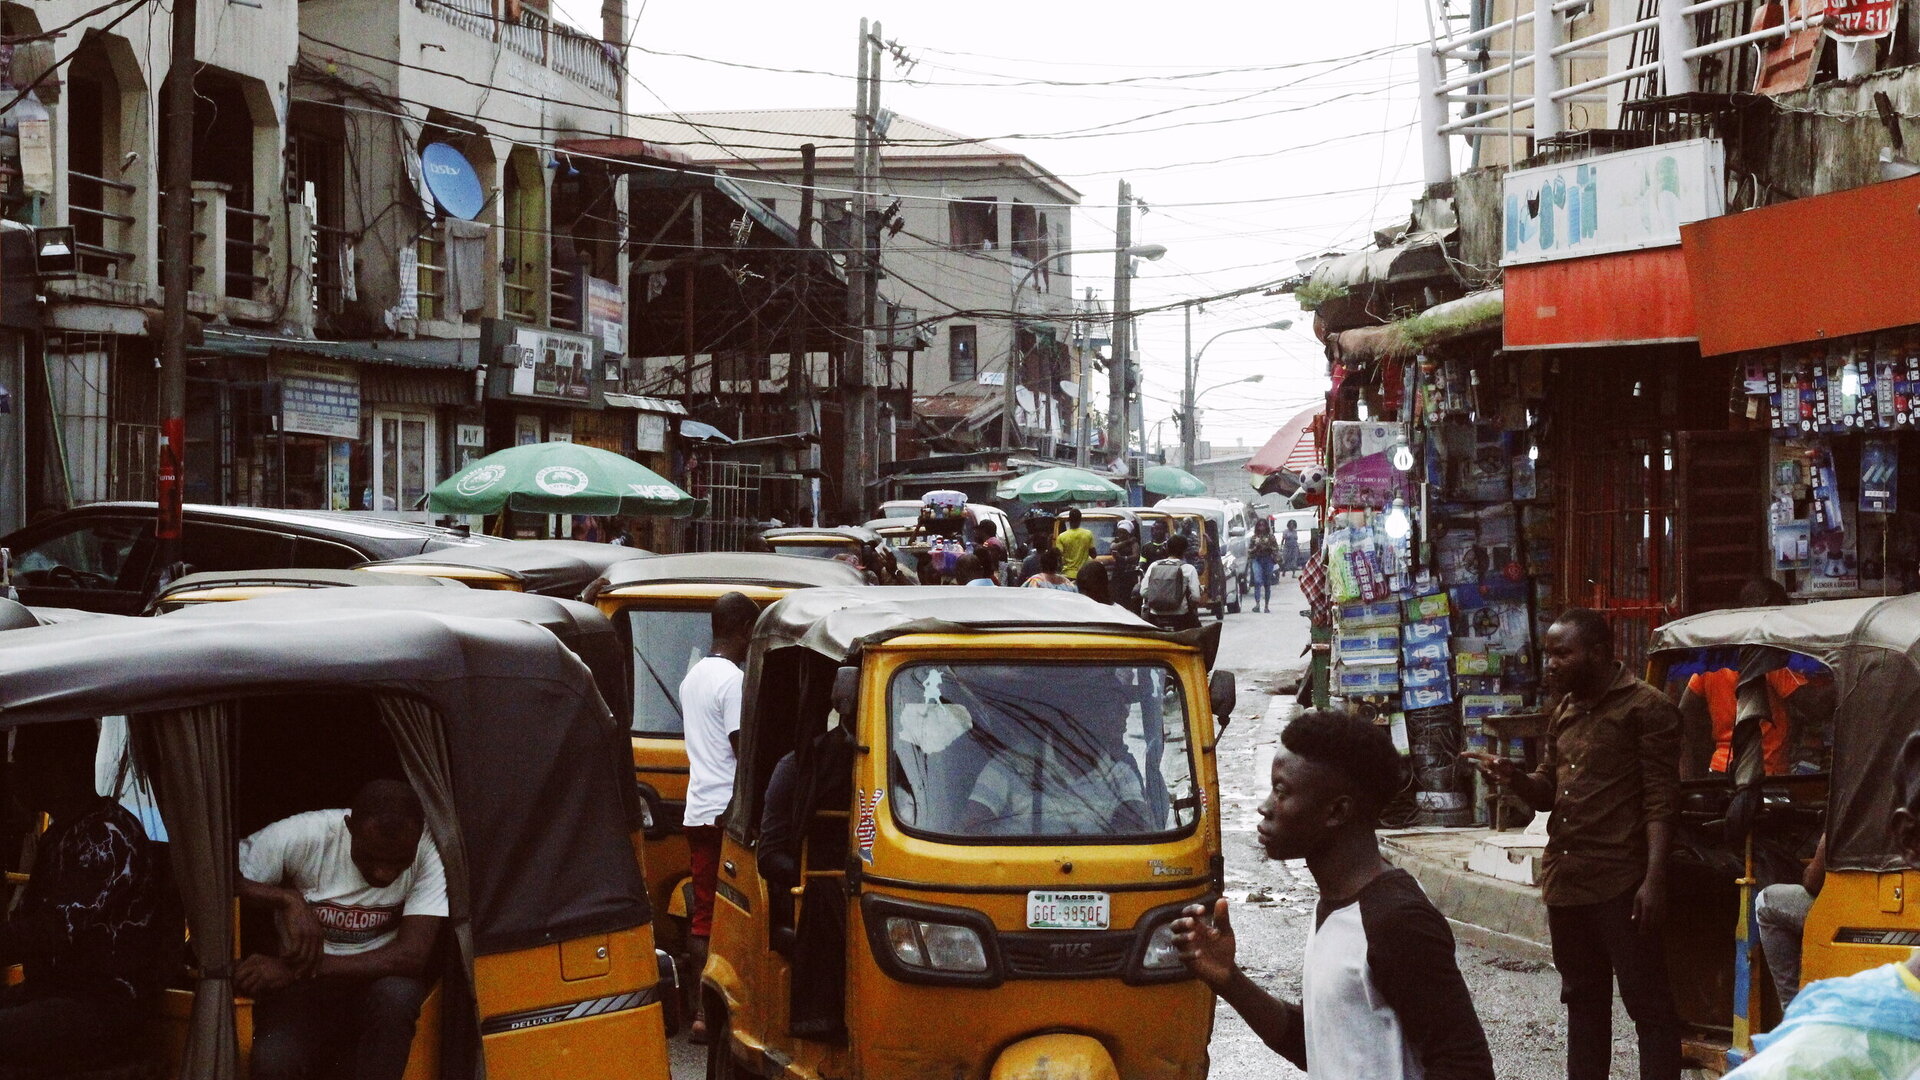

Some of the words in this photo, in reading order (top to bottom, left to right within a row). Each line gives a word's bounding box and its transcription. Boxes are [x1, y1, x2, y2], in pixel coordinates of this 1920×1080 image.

[314, 908, 390, 928] ONOGLOBIN
[1050, 943, 1091, 958] TVS
[511, 1017, 555, 1029] DELUXE
